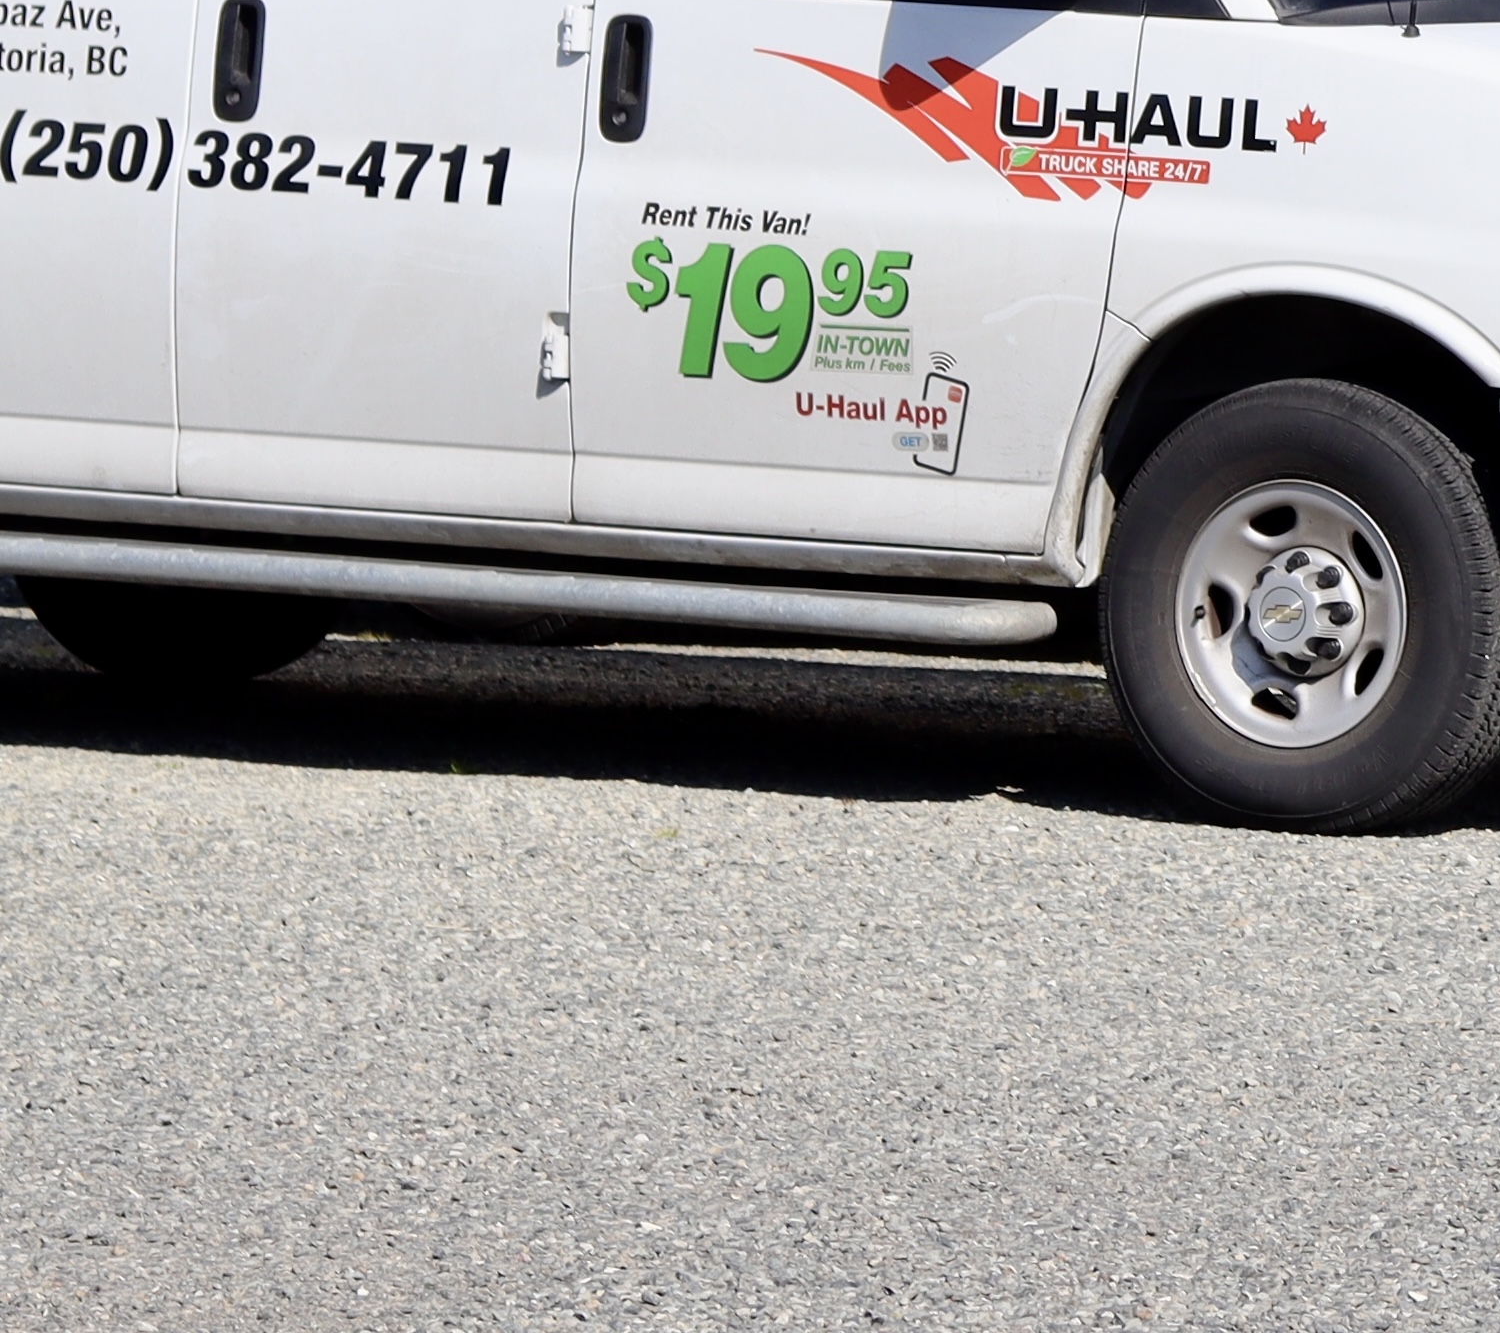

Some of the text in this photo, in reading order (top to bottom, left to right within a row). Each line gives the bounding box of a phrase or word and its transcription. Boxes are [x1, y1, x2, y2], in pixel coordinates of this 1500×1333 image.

[55, 0, 121, 39] Ave,
[86, 45, 128, 77] BC
[999, 85, 1277, 153] U-HAUL
[0, 110, 511, 207] (250) 382-4711
[1038, 152, 1203, 182] TRUCK SHARE 24/7
[641, 202, 811, 235] Rent This Van!
[815, 334, 910, 358] IN-TOWN
[814, 356, 842, 370] Plus
[845, 357, 865, 371] km
[880, 359, 911, 373] Fees
[795, 391, 948, 431] U-Haul App
[900, 436, 923, 448] GET
